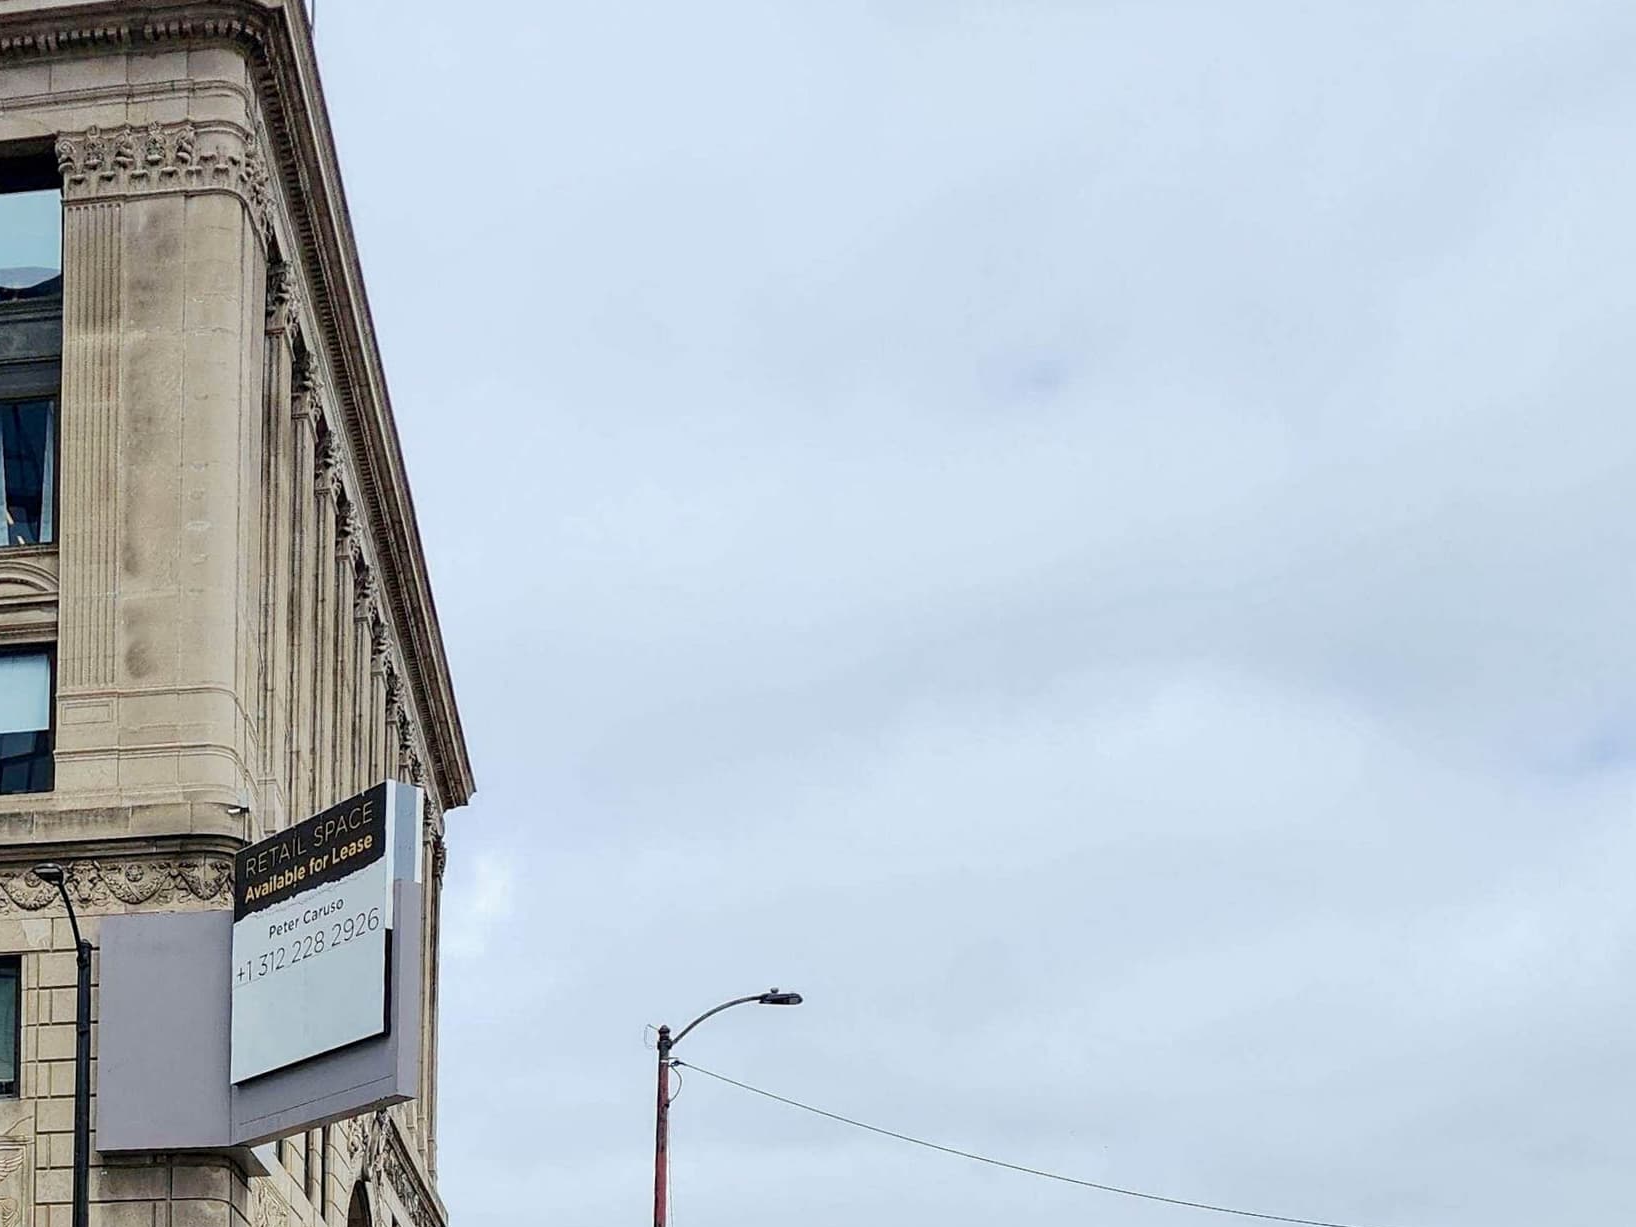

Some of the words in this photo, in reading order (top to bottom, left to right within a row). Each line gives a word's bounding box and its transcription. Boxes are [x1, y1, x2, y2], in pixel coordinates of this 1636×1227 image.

[244, 863, 306, 904] Available
[309, 853, 330, 879] for
[332, 833, 373, 865] Lease
[245, 831, 307, 878] RETAIL
[314, 800, 373, 848] SPACE
[237, 960, 253, 983] +1
[258, 948, 285, 978] 312
[292, 931, 325, 965] 228
[332, 907, 380, 947] 2926
[268, 917, 300, 940] Peter
[303, 898, 344, 926] Caruso
